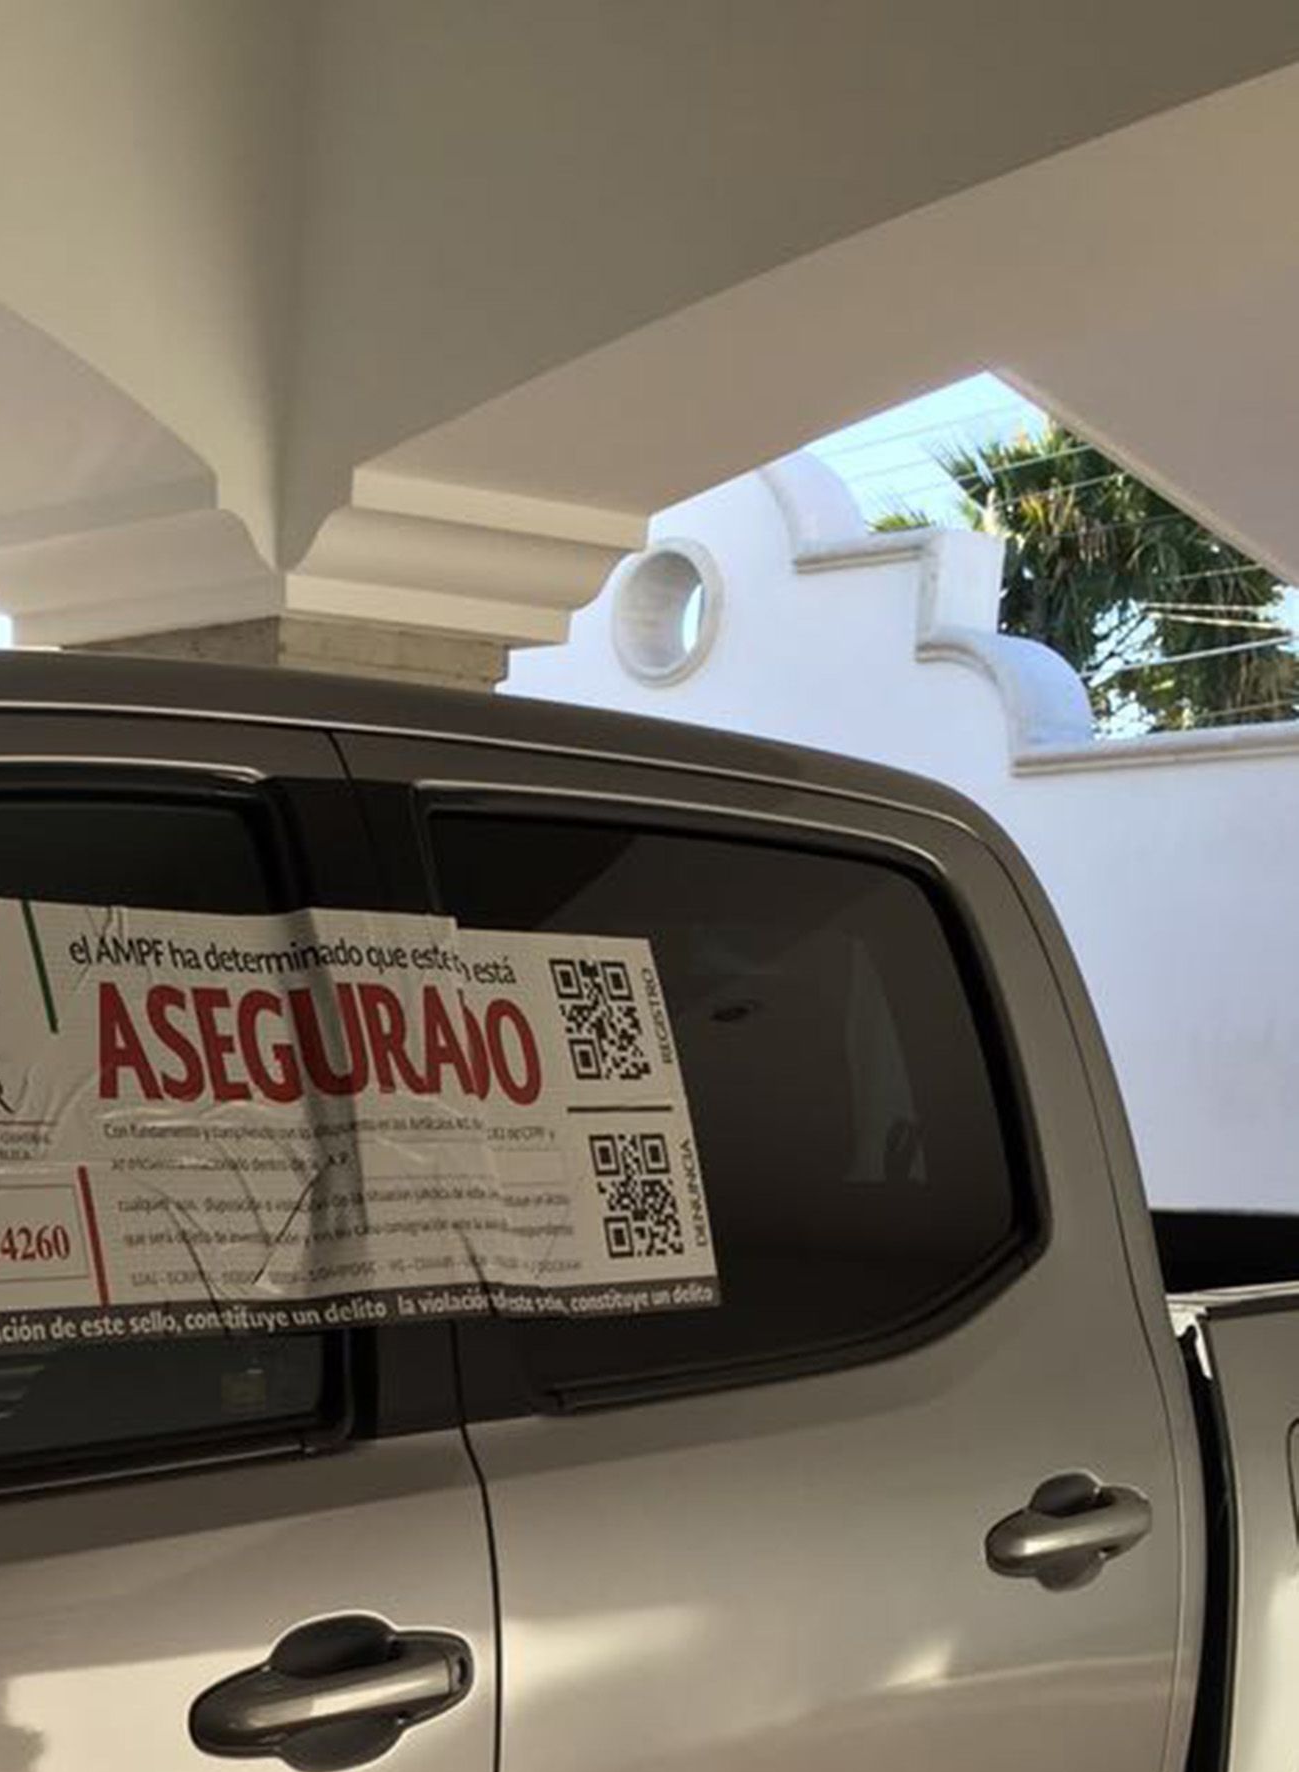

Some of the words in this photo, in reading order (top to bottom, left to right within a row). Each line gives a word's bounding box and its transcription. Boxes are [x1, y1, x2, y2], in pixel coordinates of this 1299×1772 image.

[69, 935, 92, 965] el
[96, 936, 164, 967] AMPF
[168, 941, 202, 971] ha
[204, 938, 363, 974] determinado
[367, 945, 408, 975] que
[472, 955, 517, 984] está
[642, 967, 674, 1065] REGISTRO
[679, 1139, 709, 1248] DENUNCIA
[51, 1316, 77, 1339] de
[81, 1315, 124, 1337] este
[130, 1310, 182, 1334] sello,
[292, 1310, 322, 1328] un
[324, 1296, 387, 1324] delito
[397, 1292, 417, 1315] la
[651, 1290, 670, 1306] un
[672, 1283, 713, 1304] delito
